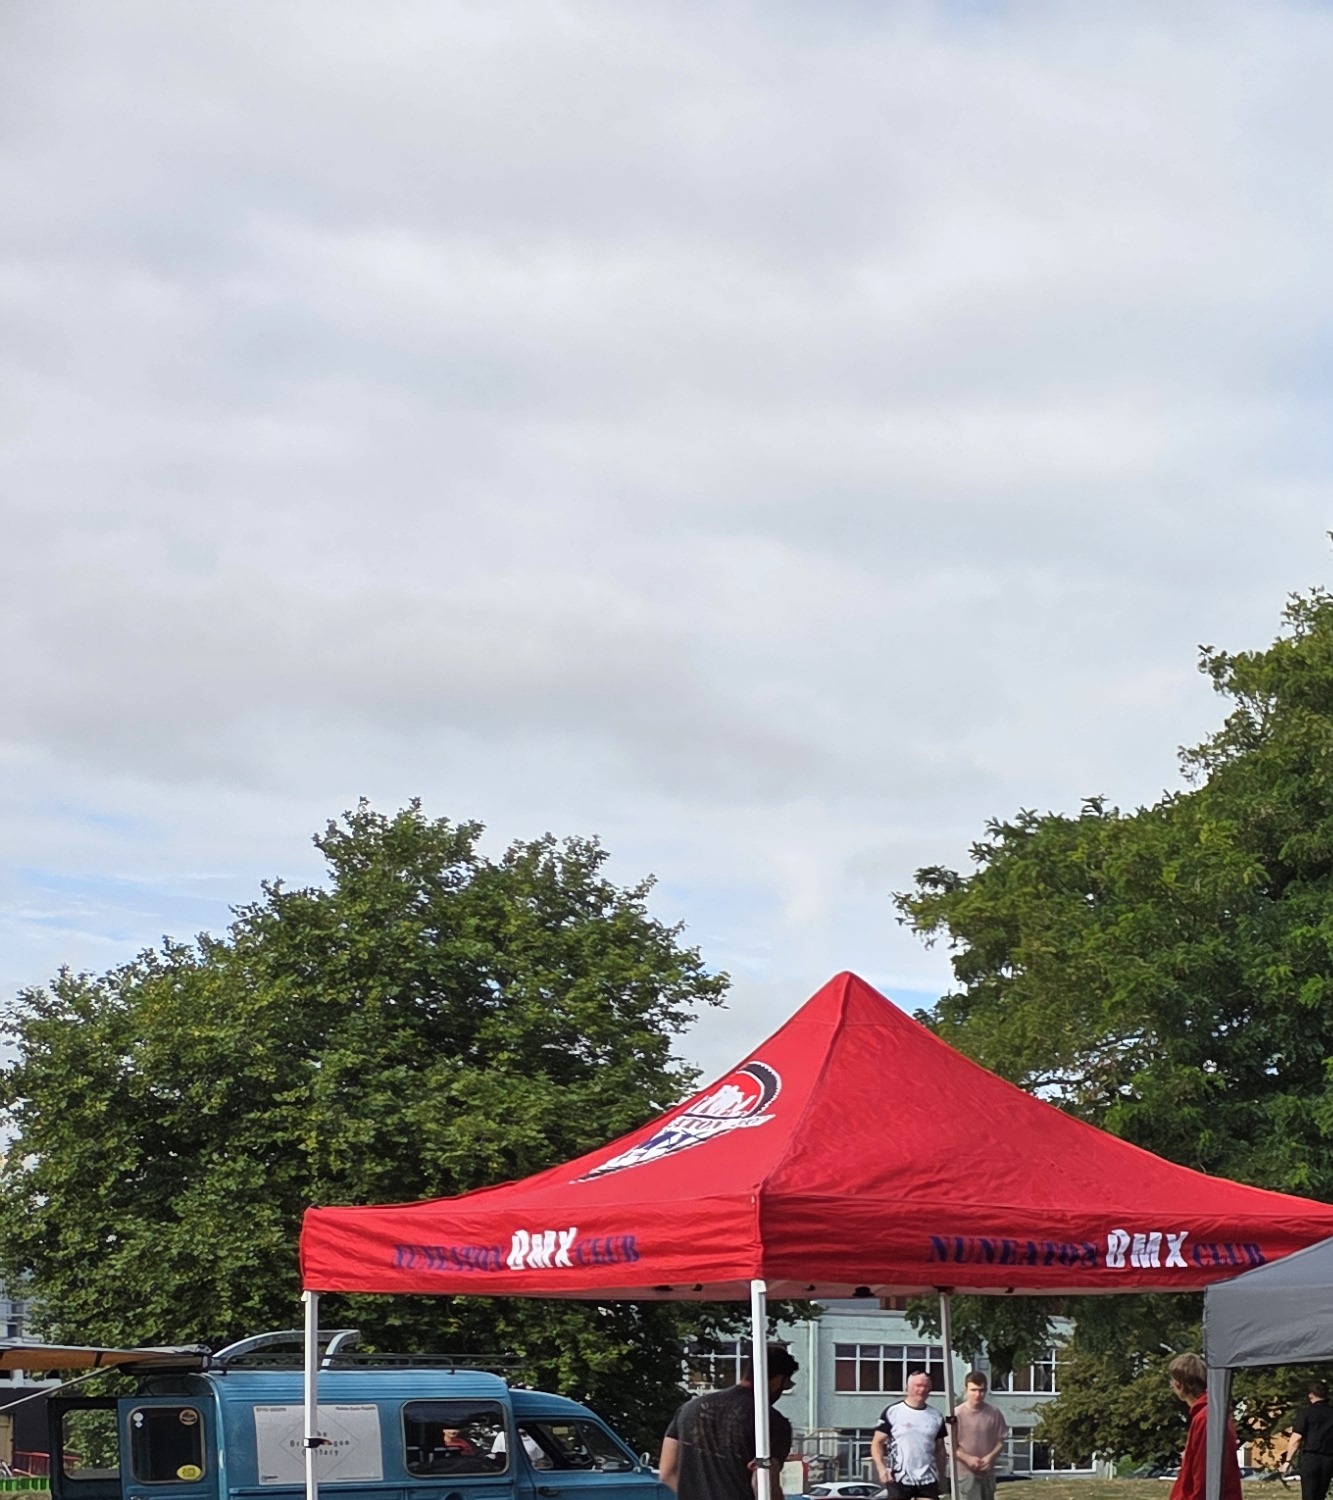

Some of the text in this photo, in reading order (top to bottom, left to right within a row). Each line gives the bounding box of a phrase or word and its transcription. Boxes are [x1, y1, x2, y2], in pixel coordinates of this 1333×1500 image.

[507, 1227, 578, 1270] BMX
[1105, 1229, 1190, 1268] BMX
[1191, 1241, 1266, 1267] CLUB
